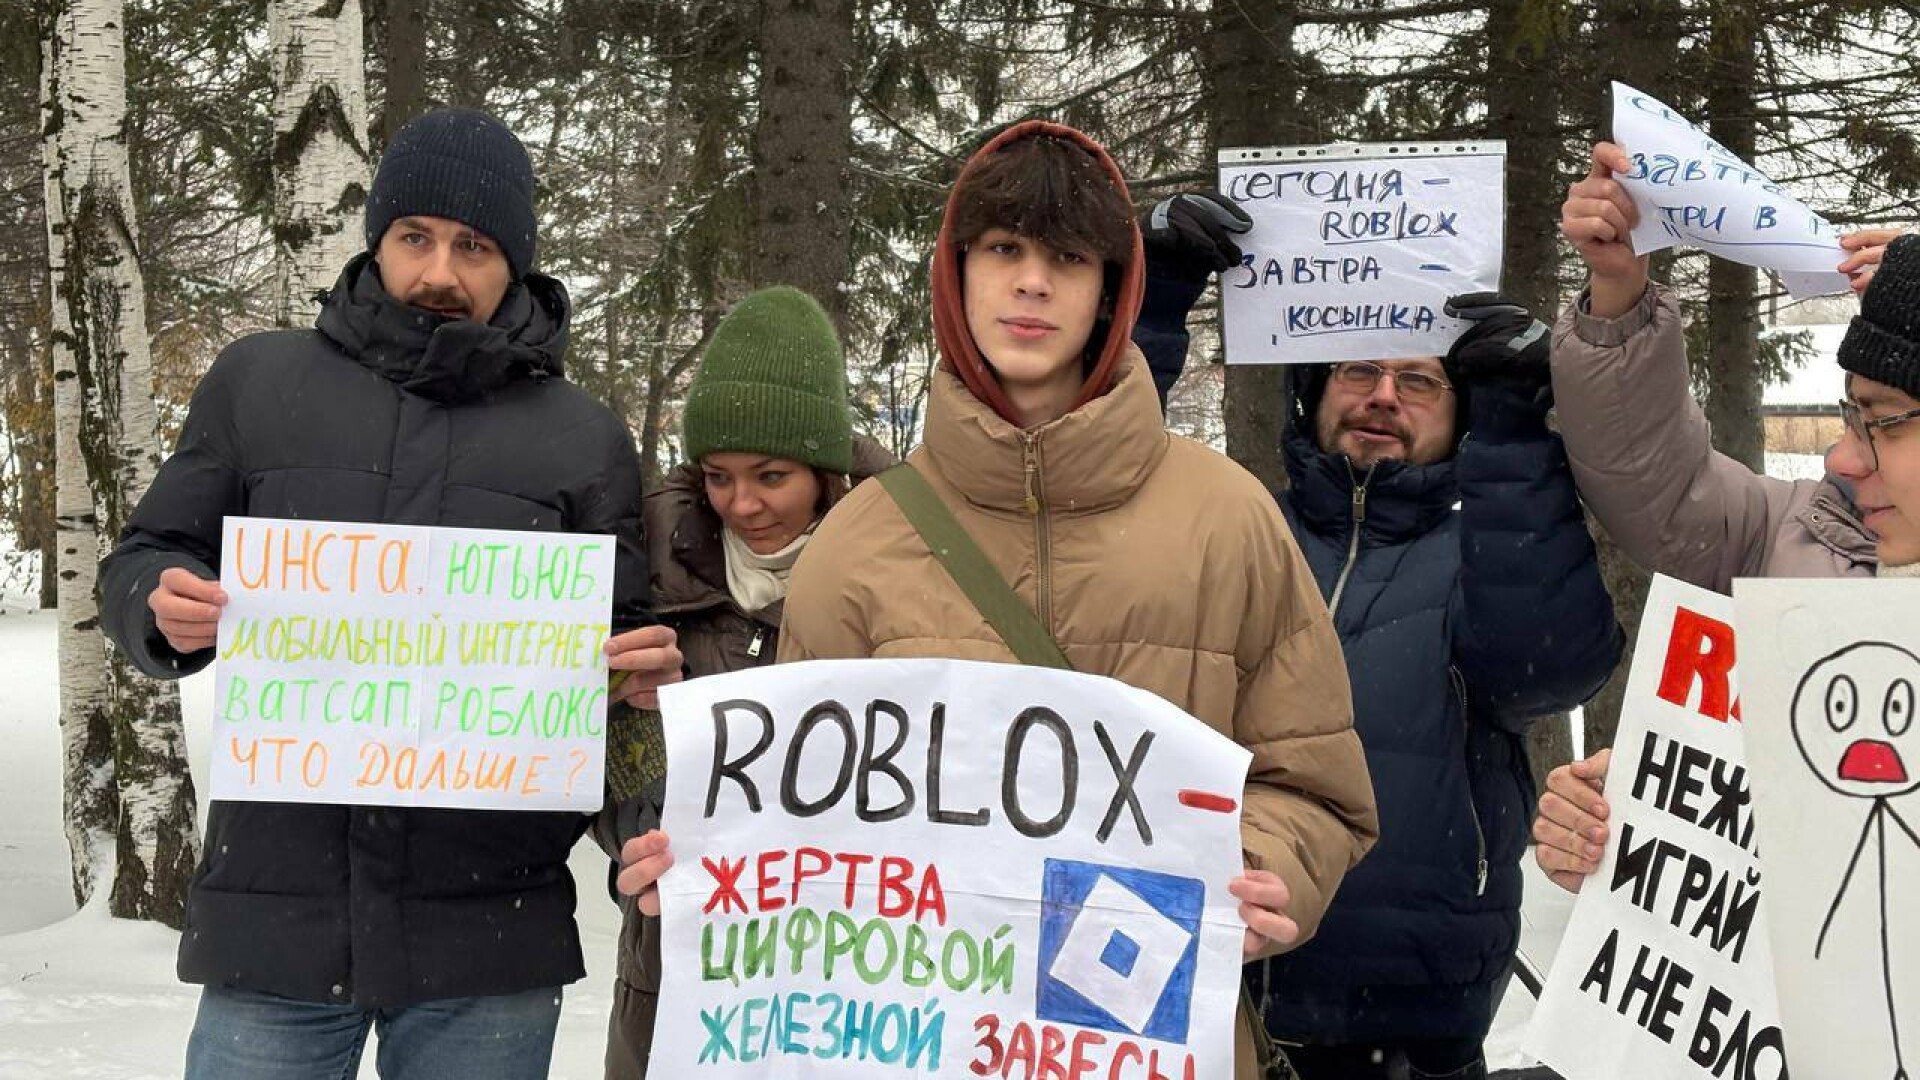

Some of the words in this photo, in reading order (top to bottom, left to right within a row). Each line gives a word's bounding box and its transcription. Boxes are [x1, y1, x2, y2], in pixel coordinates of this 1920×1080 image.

[1658, 205, 1727, 233] ТРИ
[1753, 206, 1778, 231] В
[1233, 253, 1383, 289] ЗАВТРА
[221, 613, 448, 667] МОБИЛЬНЫЙ
[1656, 606, 1742, 723] R
[433, 680, 606, 740] РОБЛОКС
[231, 736, 330, 789] ЧТО
[703, 699, 1157, 846] ROBLOX
[701, 847, 947, 927] ЖЕРТВА
[1610, 822, 1762, 964] ИГРАЙ
[701, 907, 1016, 995] ЦИФРОВОЙ
[1579, 928, 1619, 1004] А
[1616, 944, 1695, 1045] НЕ
[697, 992, 947, 1073] ЖЕЛЕЗНОЙ
